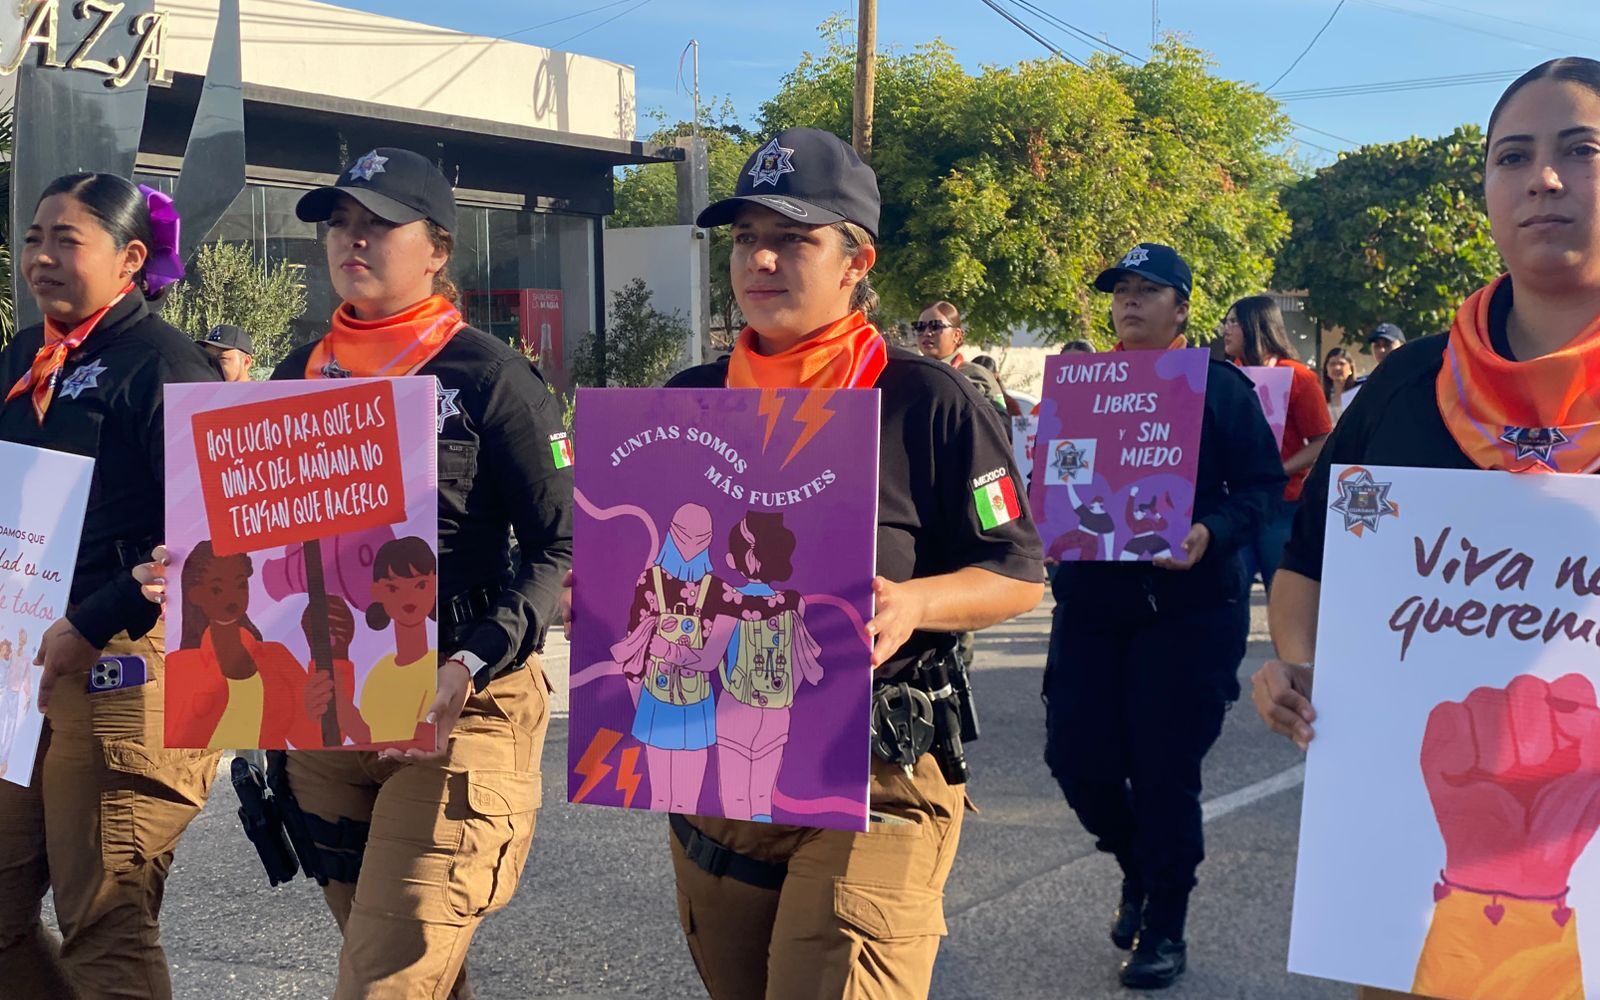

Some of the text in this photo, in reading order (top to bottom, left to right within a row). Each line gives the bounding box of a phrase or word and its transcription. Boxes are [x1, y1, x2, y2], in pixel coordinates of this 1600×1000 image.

[1056, 362, 1129, 384] JUNTAS
[1092, 392, 1158, 414] LIBRES
[206, 396, 385, 462] HOY LUCHO PARA QUE LAS
[1137, 422, 1171, 442] SIN
[610, 425, 748, 474] JUNTAS SOMOS
[1120, 446, 1183, 468] MIEDO
[221, 440, 383, 499] NIÑAS DEL MAÑANA NO
[973, 467, 1006, 488] MEXICO
[704, 465, 837, 507] MÁS FUERTES
[229, 482, 389, 538] TENGAN QUE HACERLO
[27, 532, 45, 544] QUE
[25, 563, 39, 576] es
[1413, 526, 1535, 591] Viva
[1388, 596, 1600, 662] querem
